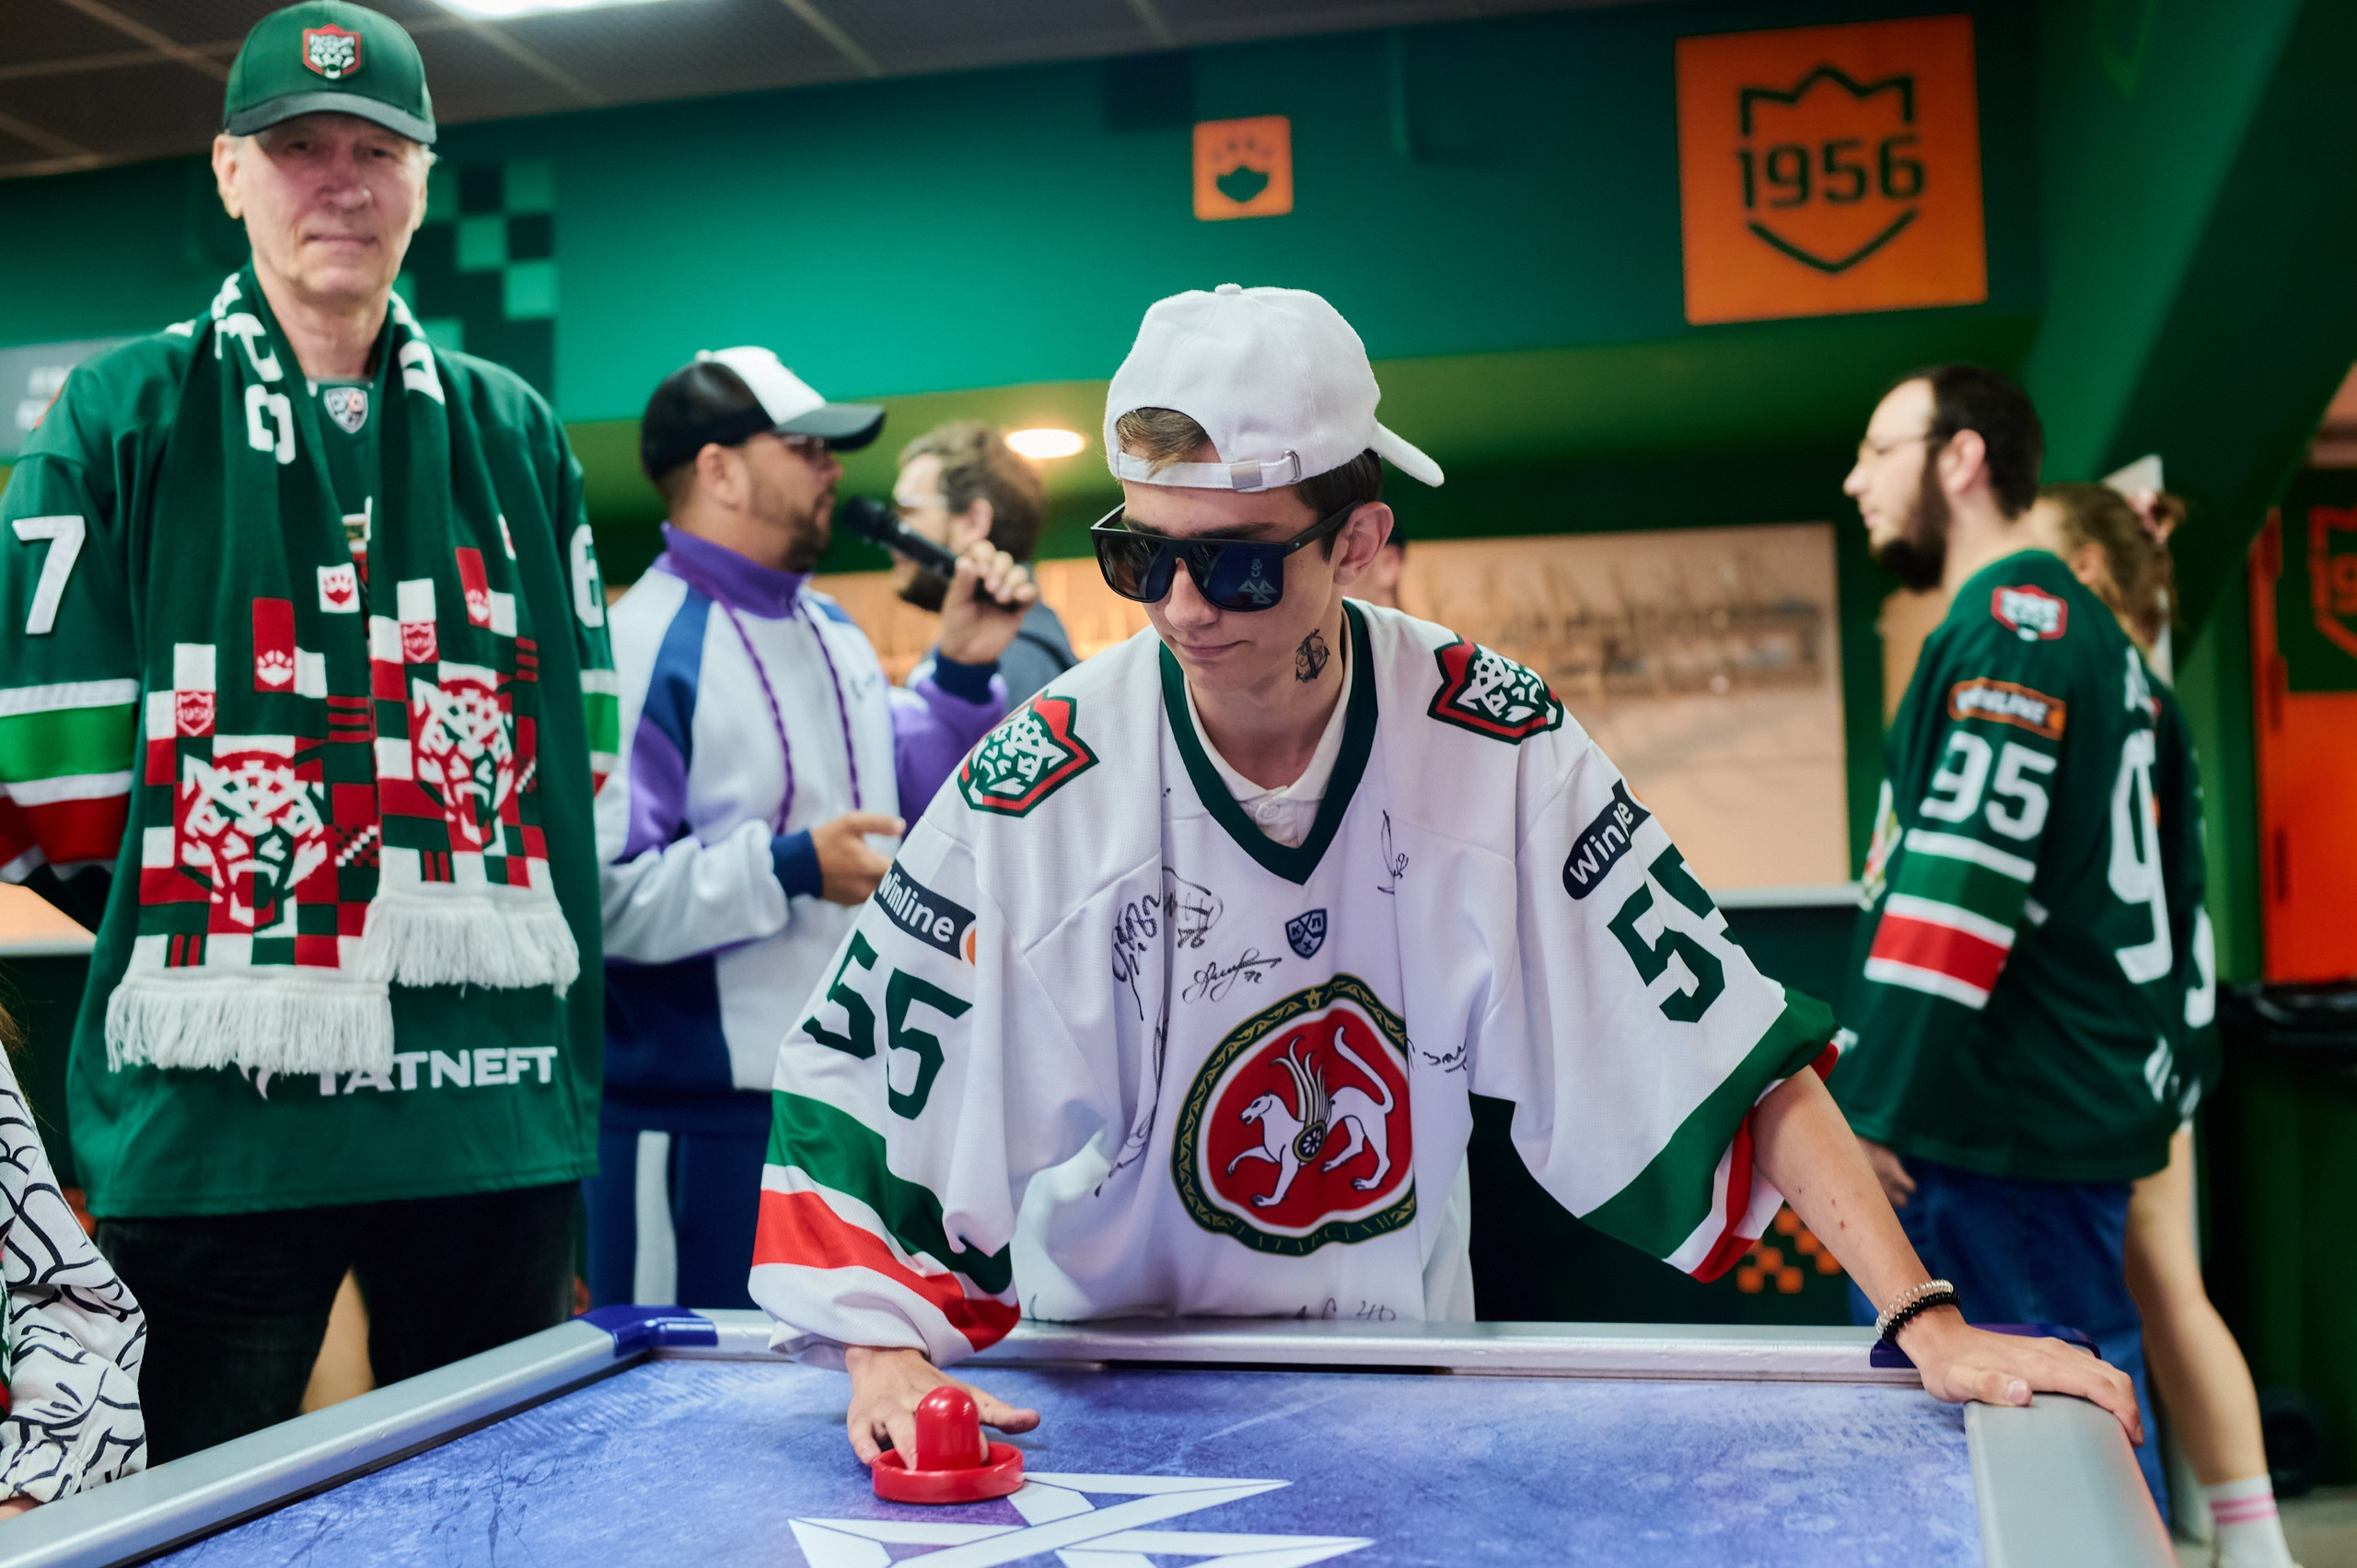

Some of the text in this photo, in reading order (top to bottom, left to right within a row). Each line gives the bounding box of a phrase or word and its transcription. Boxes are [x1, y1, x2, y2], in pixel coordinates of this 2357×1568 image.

[1738, 135, 1924, 208] 1956
[1920, 730, 2058, 842] 95
[877, 872, 955, 943] Winline
[801, 928, 973, 1121] 55
